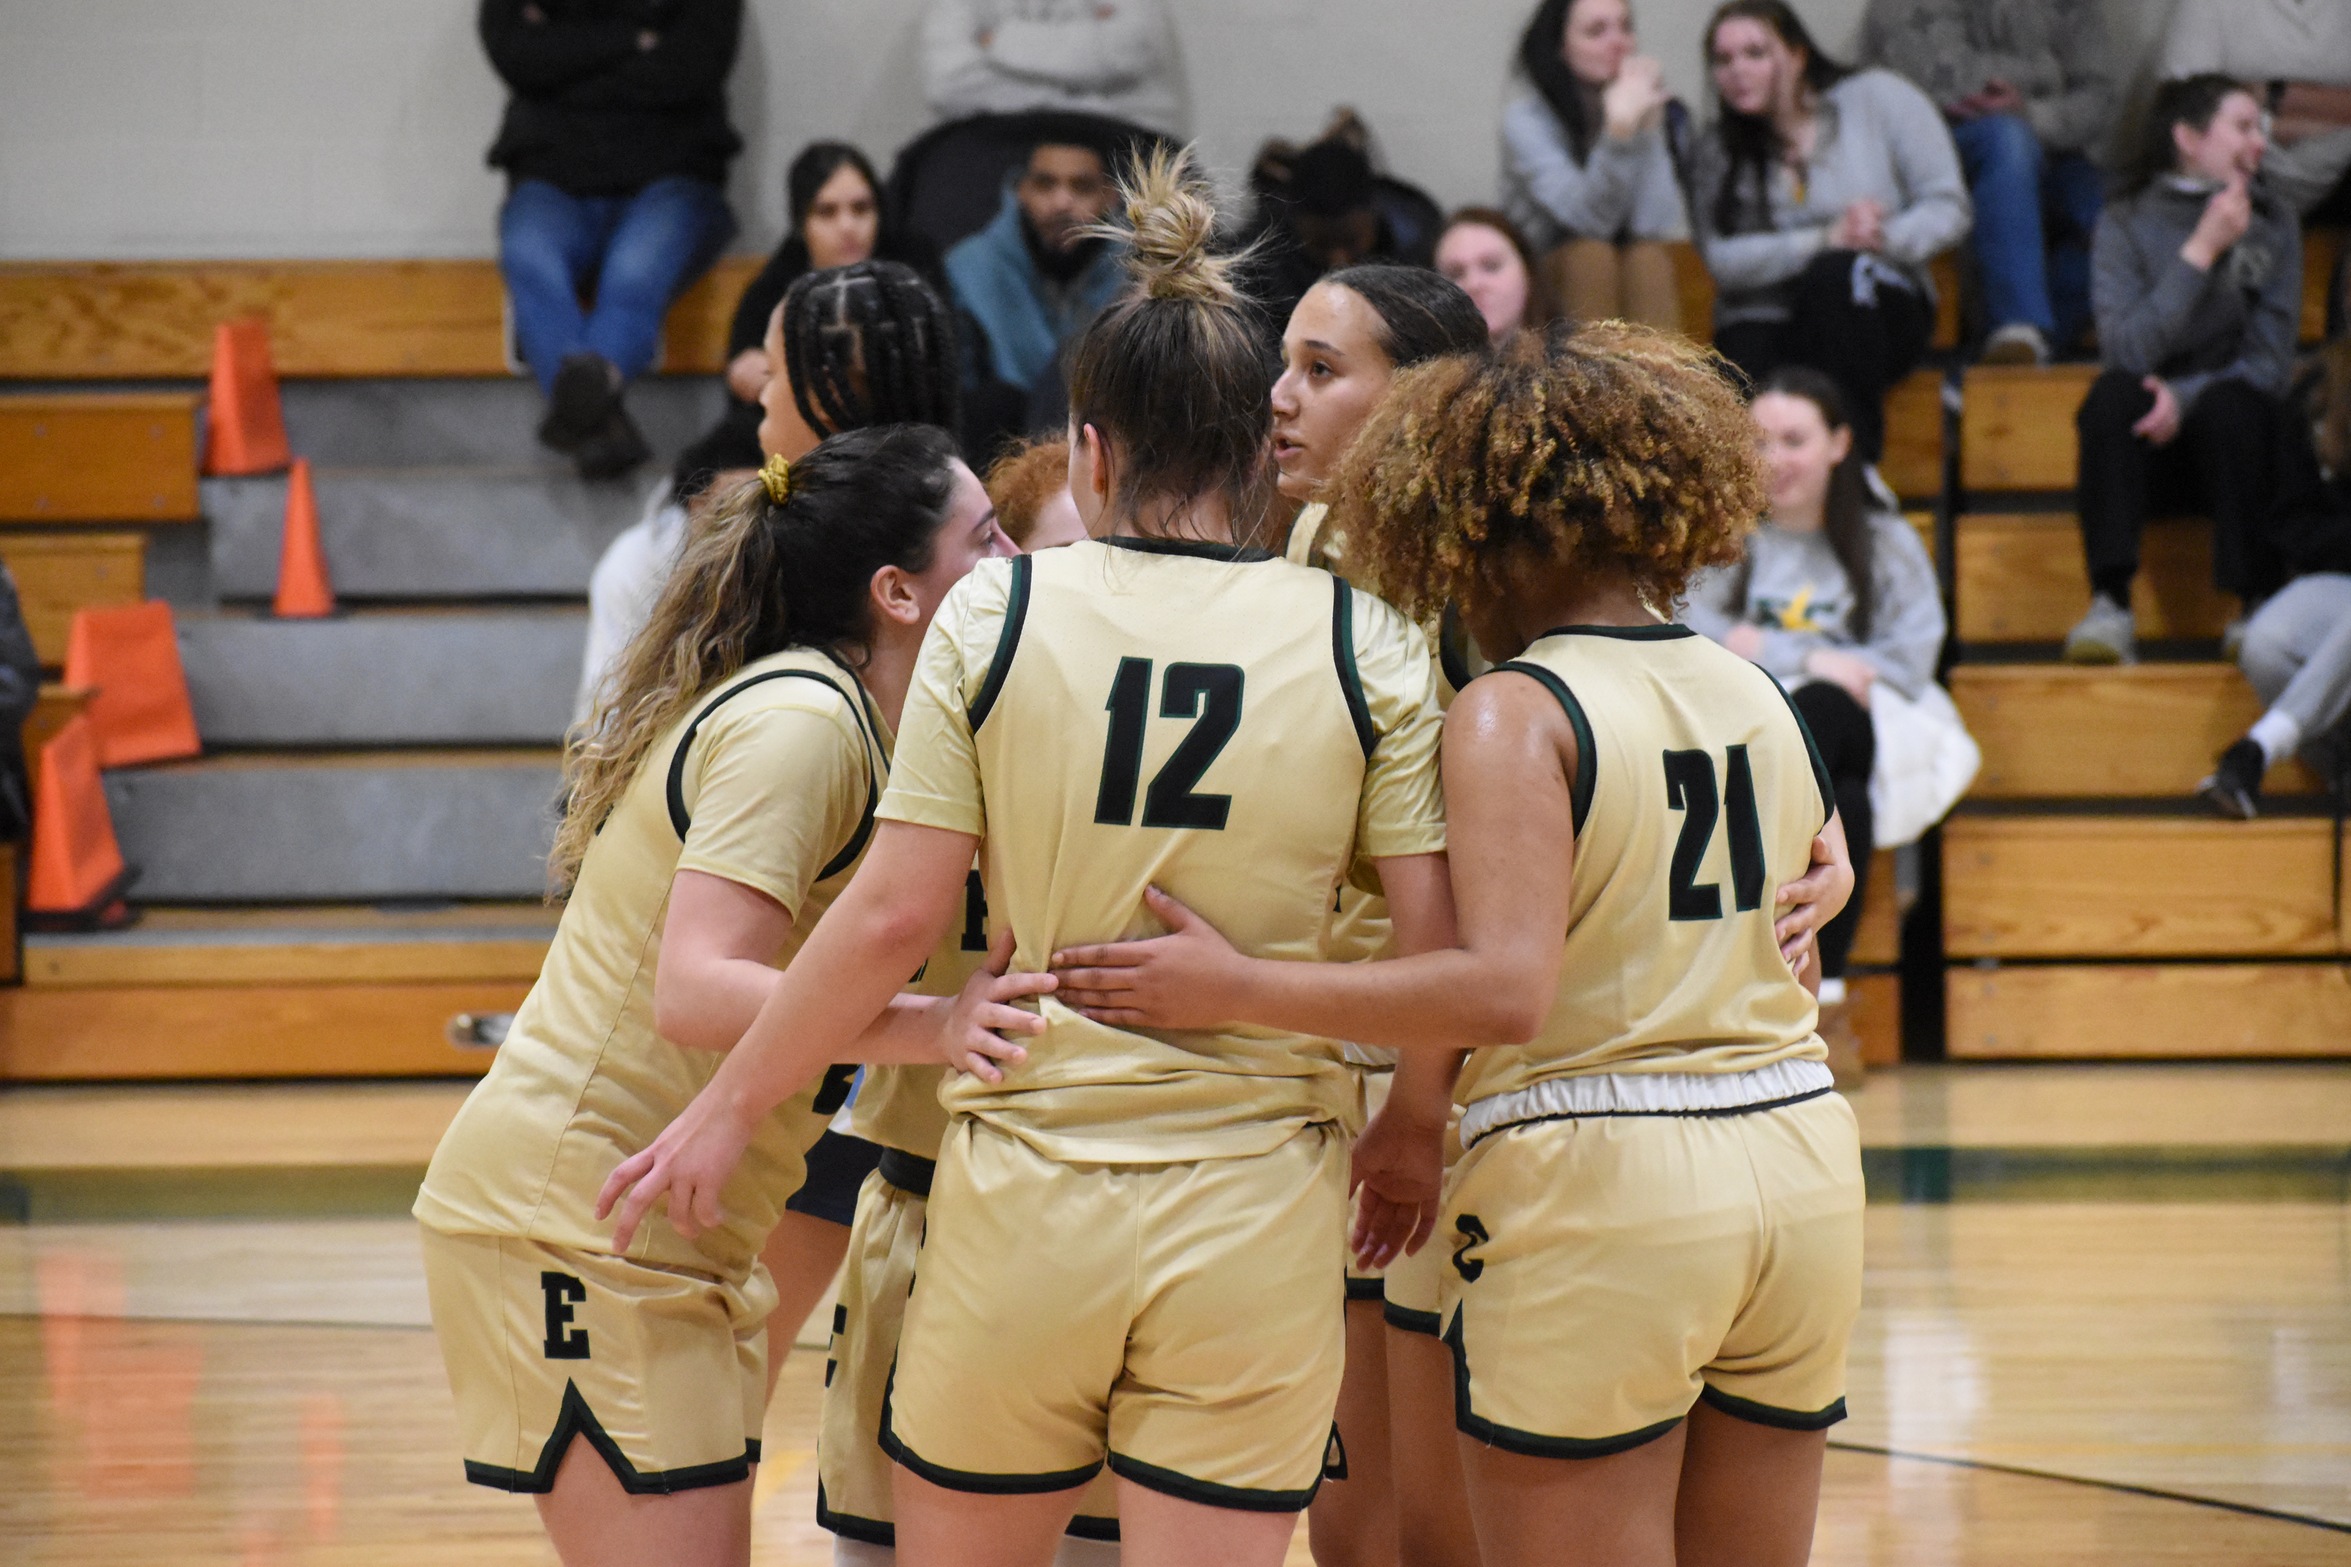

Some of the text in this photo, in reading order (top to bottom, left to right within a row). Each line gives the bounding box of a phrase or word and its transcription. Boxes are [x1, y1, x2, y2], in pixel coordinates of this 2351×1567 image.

[1094, 656, 1245, 830] 12
[1663, 743, 1766, 921] 21
[541, 1271, 591, 1360] E
